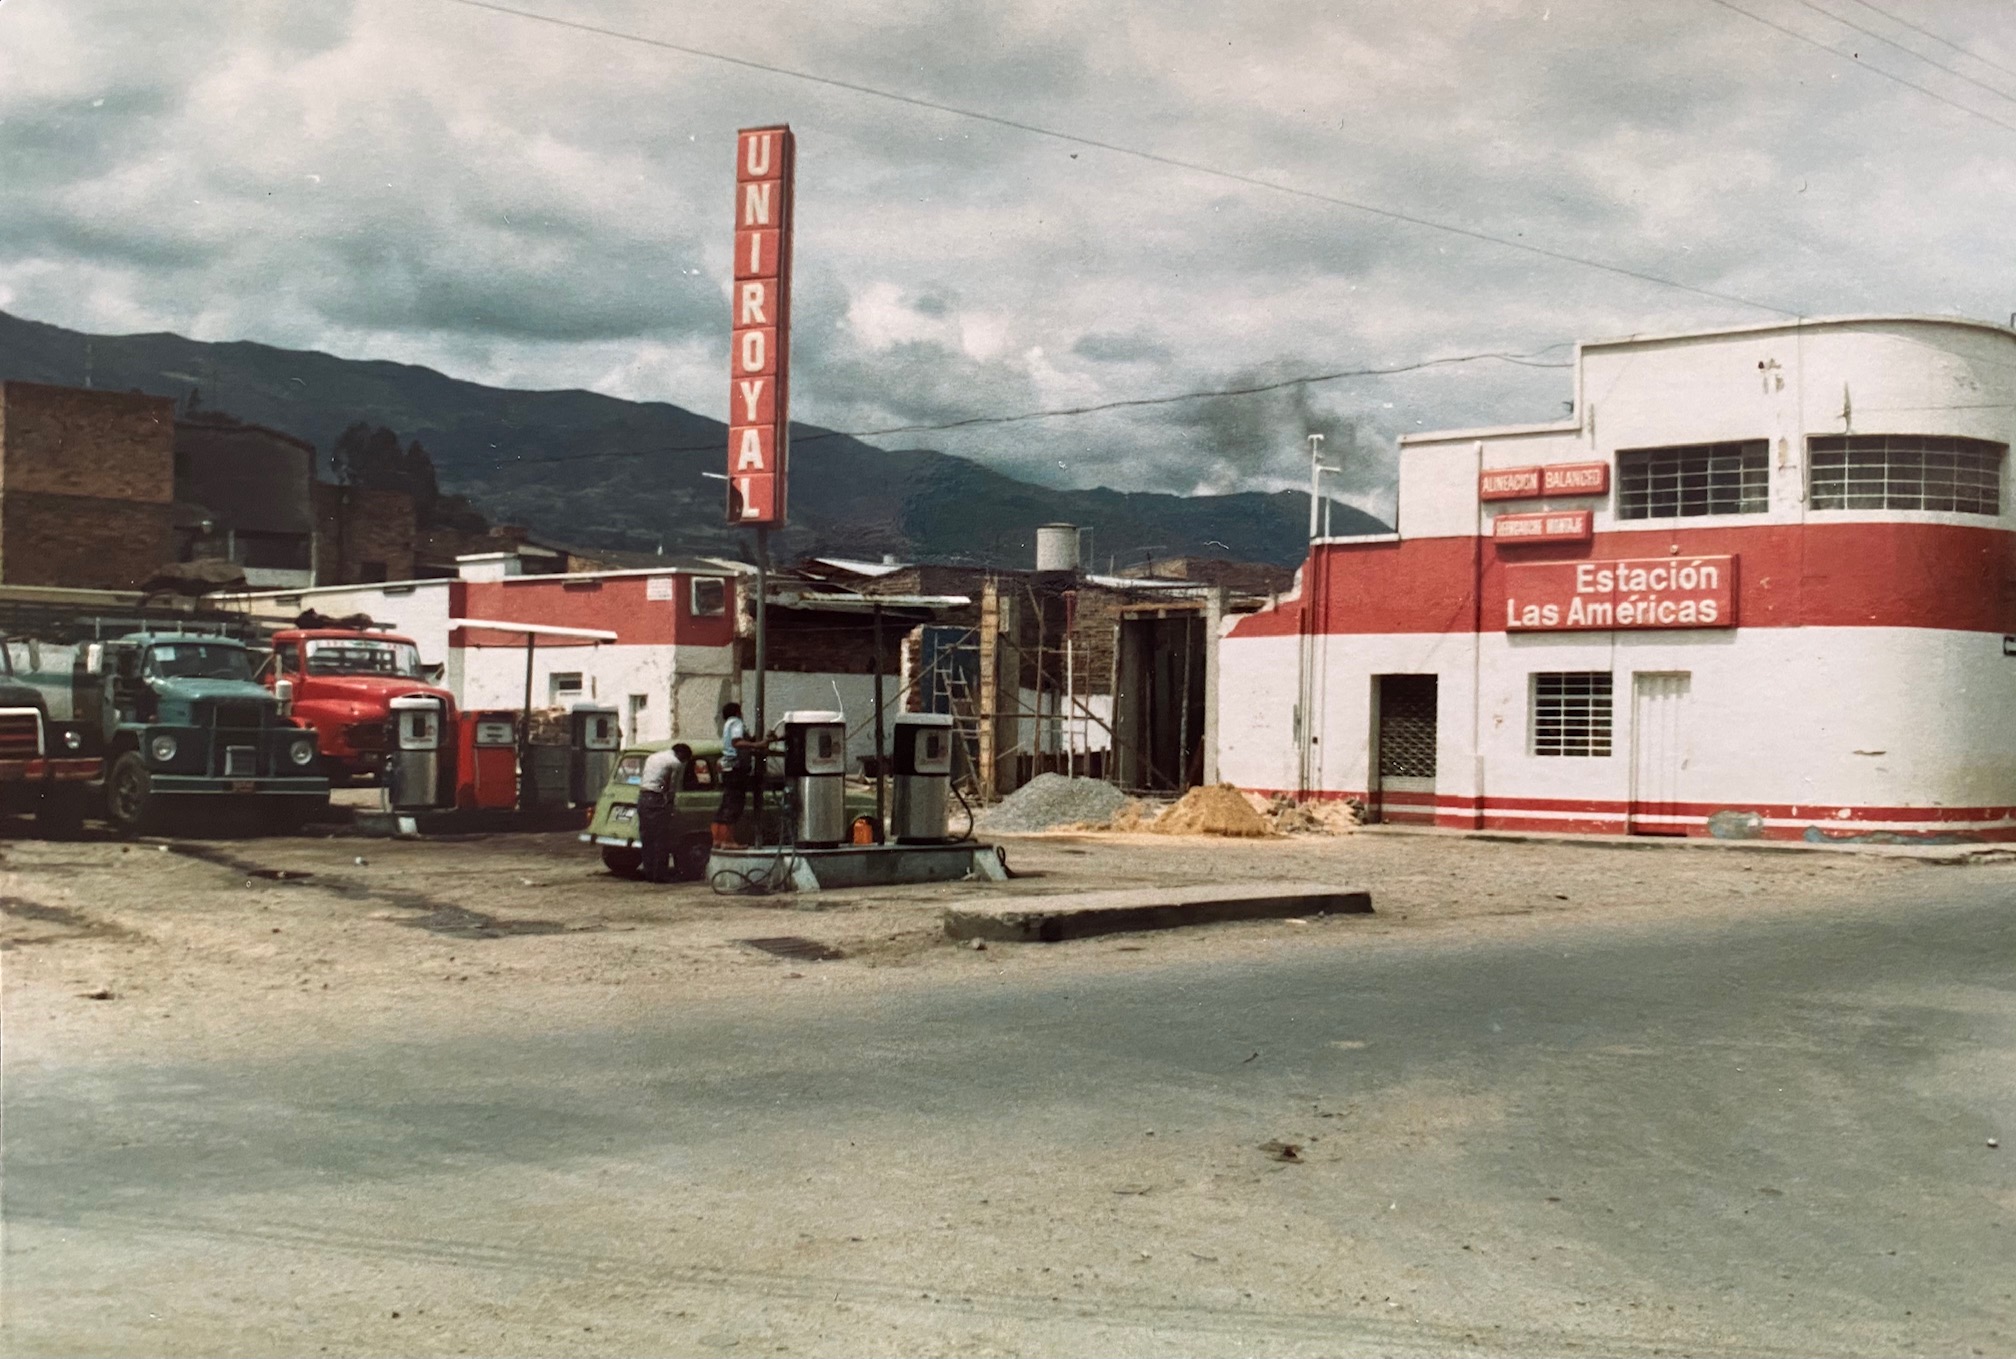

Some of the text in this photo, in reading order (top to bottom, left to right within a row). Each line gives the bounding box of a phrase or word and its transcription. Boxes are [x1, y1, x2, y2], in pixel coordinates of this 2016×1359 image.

[737, 136, 771, 519] UNIROYAL
[1545, 470, 1600, 488] BALANCEO
[1576, 561, 1718, 593] Estación
[1507, 594, 1718, 627] Las Américas
